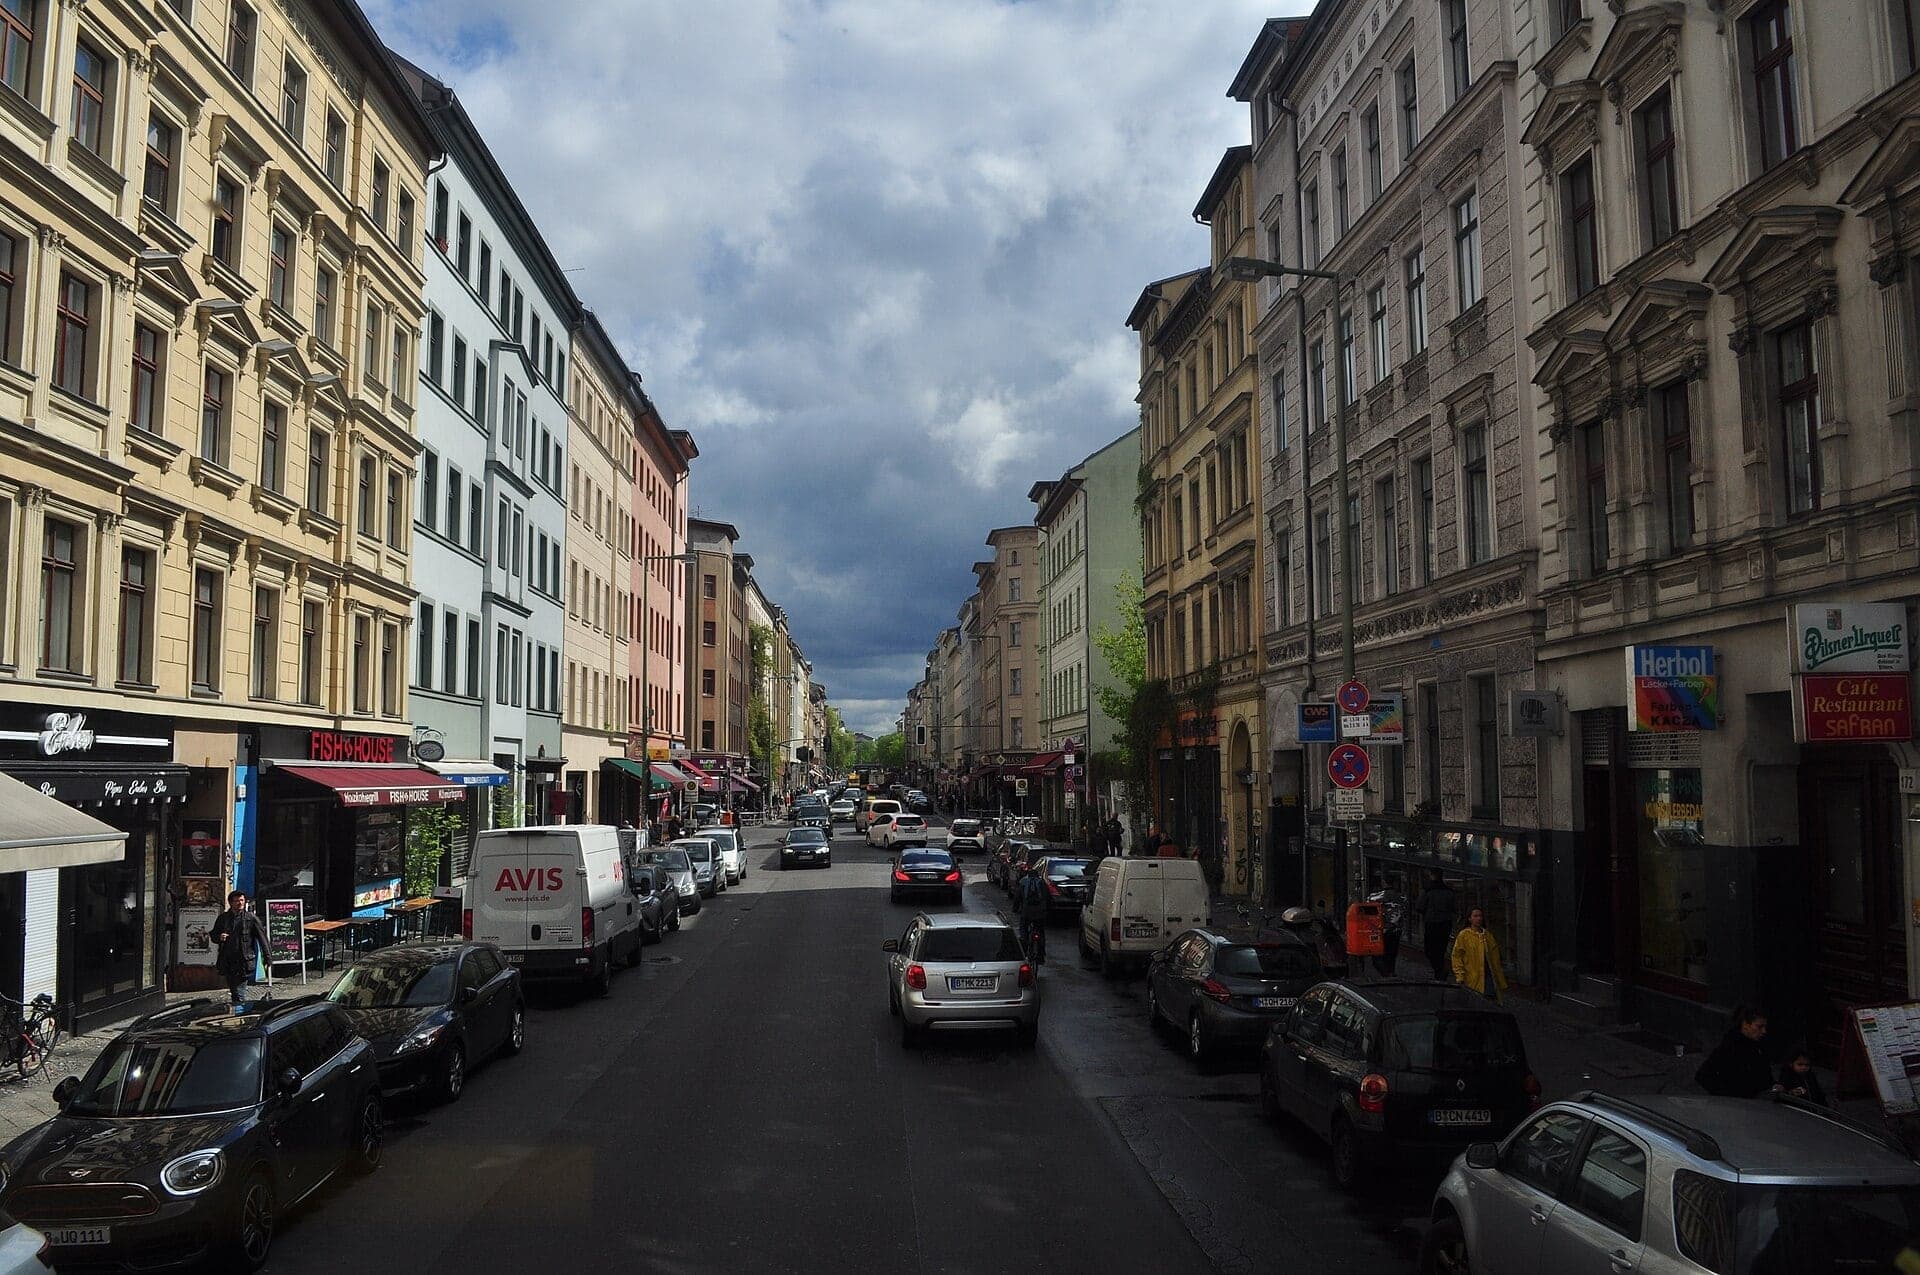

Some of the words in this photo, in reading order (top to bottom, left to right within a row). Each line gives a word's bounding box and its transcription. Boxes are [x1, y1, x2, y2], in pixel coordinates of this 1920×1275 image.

[1805, 627, 1853, 669] Pilsner
[1852, 624, 1902, 652] Urquell
[1641, 649, 1706, 676] Herbol
[1837, 679, 1879, 696] Cafe
[1813, 696, 1905, 713] Restaurant
[312, 732, 343, 761] FISH
[354, 737, 395, 763] HOUSE
[390, 791, 404, 803] FISH
[408, 789, 429, 801] HOUSE
[495, 868, 563, 892] AVIS
[1436, 1110, 1441, 1121] B
[1449, 1110, 1463, 1122] CN
[1464, 1110, 1490, 1122] 4419
[79, 1229, 104, 1243] 111
